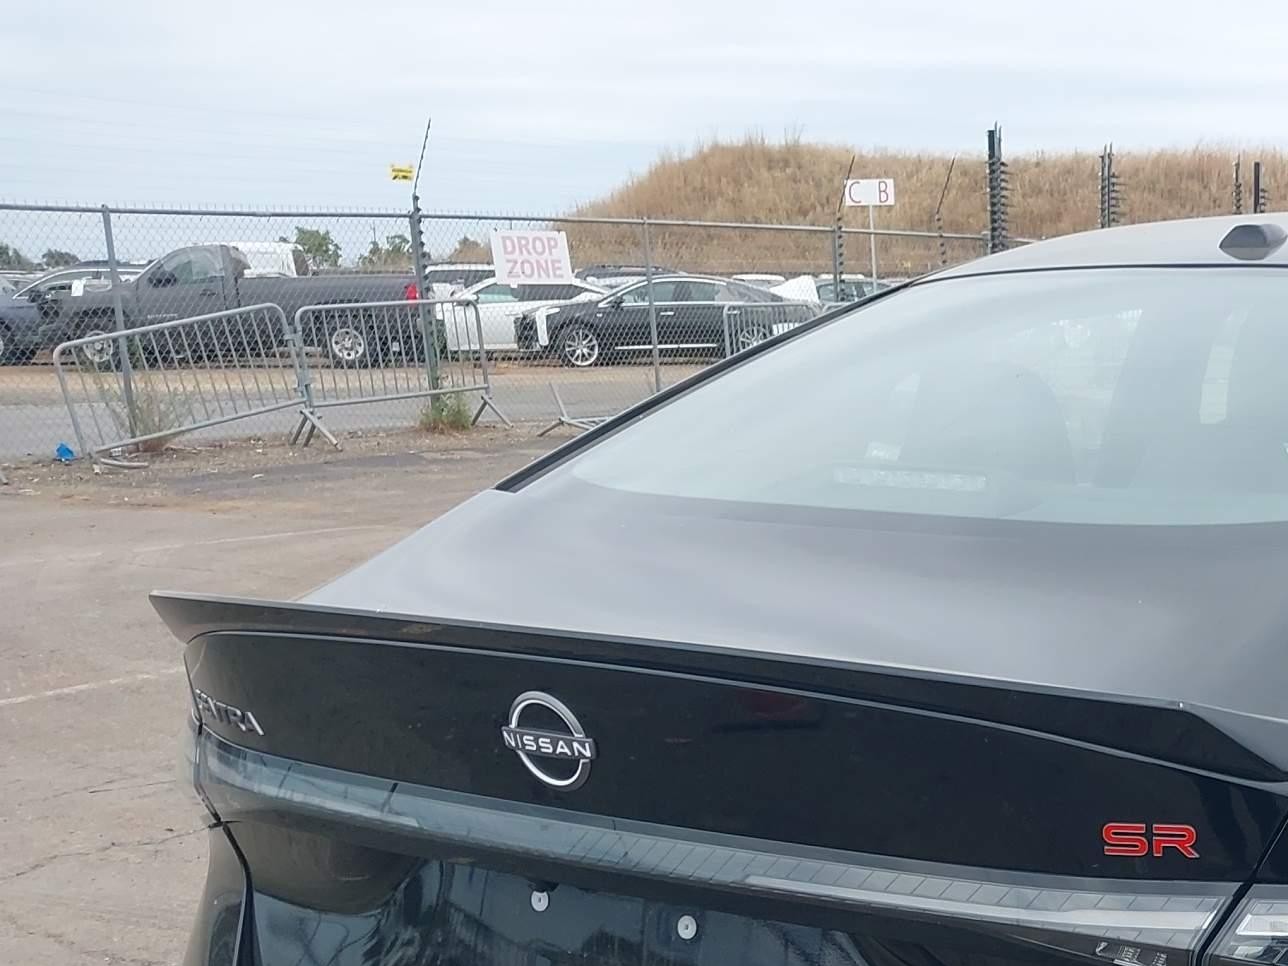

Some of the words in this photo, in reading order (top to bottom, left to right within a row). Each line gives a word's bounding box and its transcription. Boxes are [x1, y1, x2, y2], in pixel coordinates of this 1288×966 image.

[849, 181, 861, 203] C
[878, 181, 889, 203] B
[501, 235, 559, 256] DROP
[505, 259, 564, 278] ZONE
[502, 730, 591, 757] NISSAN
[1102, 822, 1199, 858] SR
